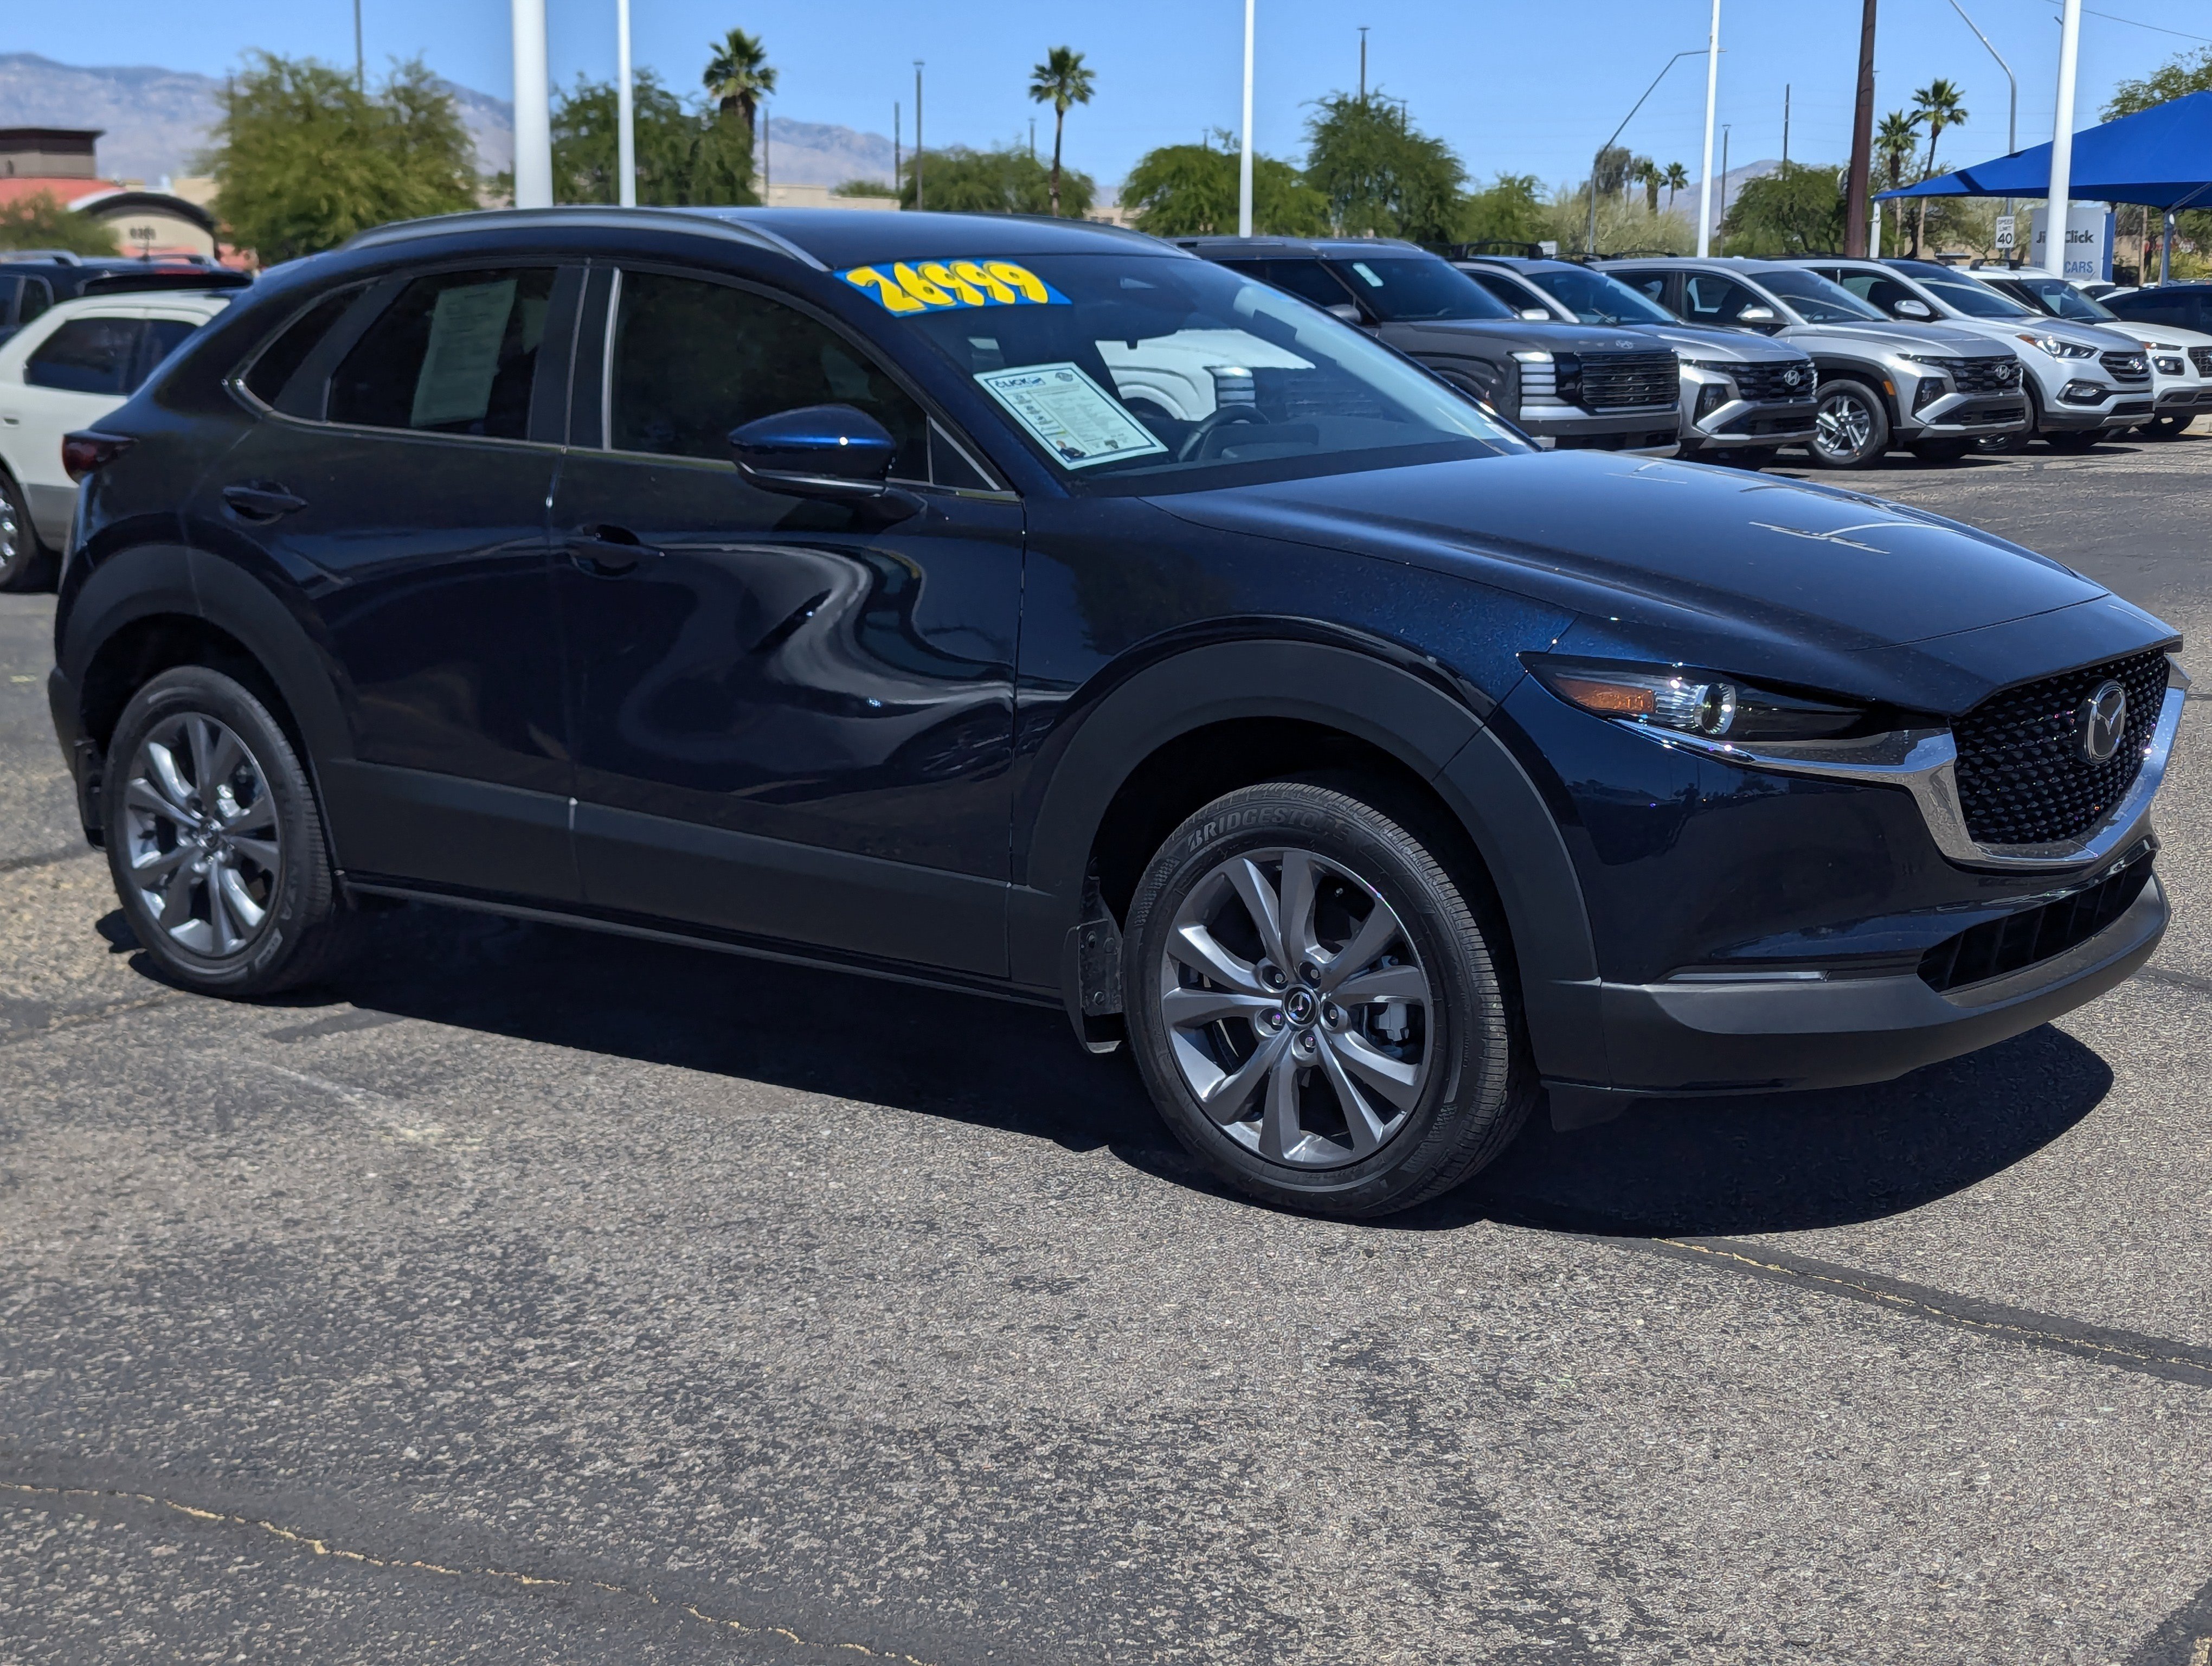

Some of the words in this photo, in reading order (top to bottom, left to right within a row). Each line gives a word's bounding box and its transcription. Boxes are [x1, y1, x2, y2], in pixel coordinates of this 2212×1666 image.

[1997, 233, 2012, 244] 40
[2036, 230, 2047, 244] Ji
[2065, 261, 2094, 273] CARS
[846, 261, 1049, 312] 26999
